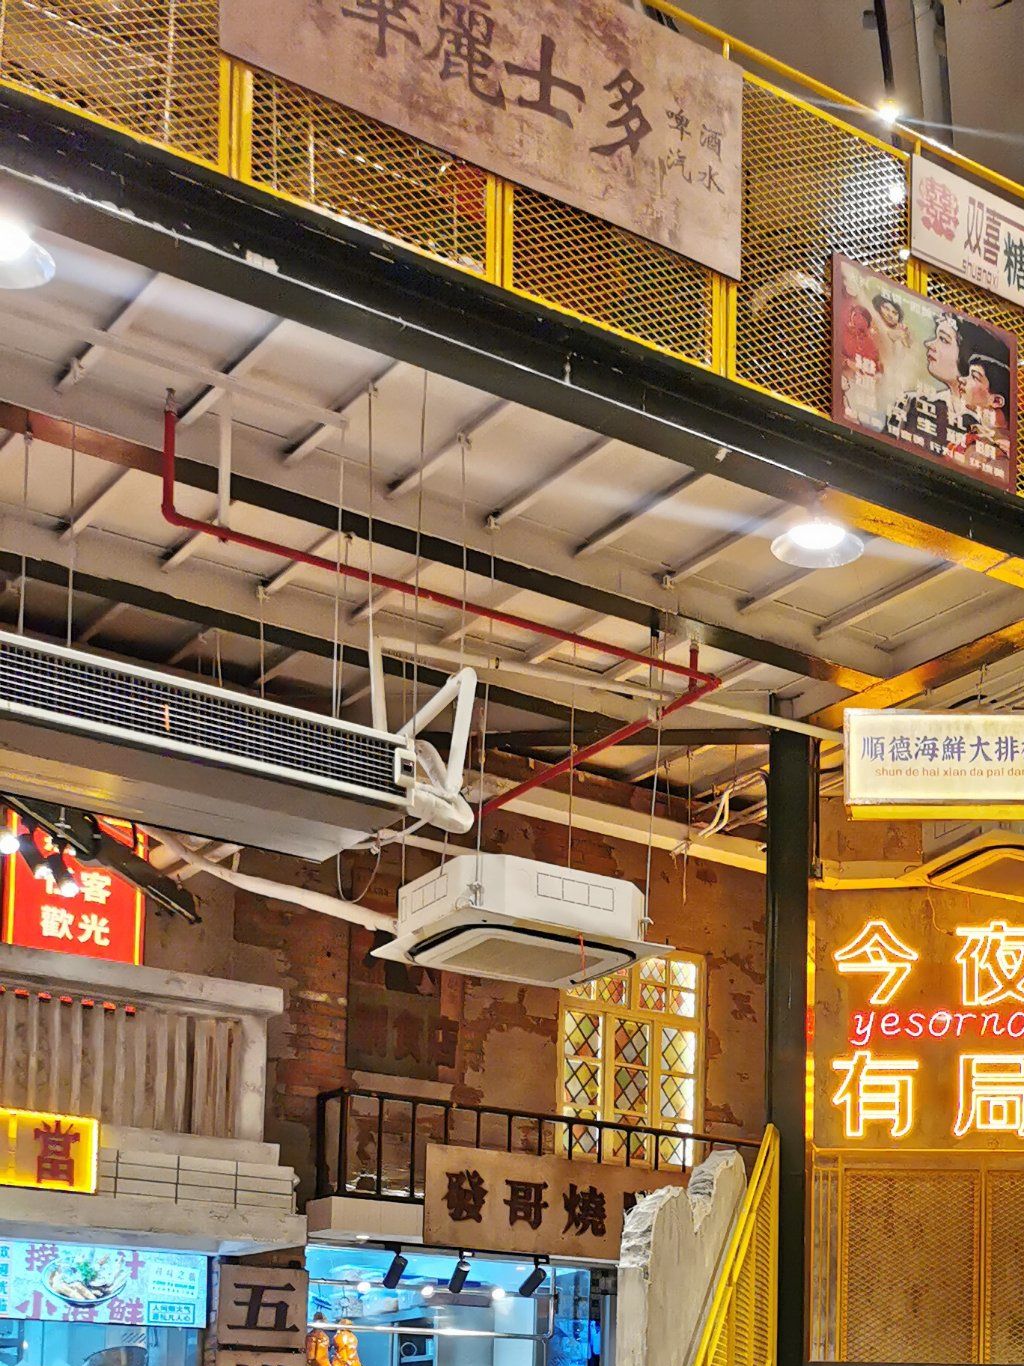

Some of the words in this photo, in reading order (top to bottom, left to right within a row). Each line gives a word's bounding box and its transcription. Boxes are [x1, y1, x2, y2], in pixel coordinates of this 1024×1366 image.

[875, 767, 903, 777] shun
[905, 767, 919, 777] de
[922, 767, 940, 777] hai
[943, 767, 966, 777] xian
[969, 767, 984, 777] da
[986, 767, 1004, 778] pai
[442, 1169, 652, 1238] 發哥燒
